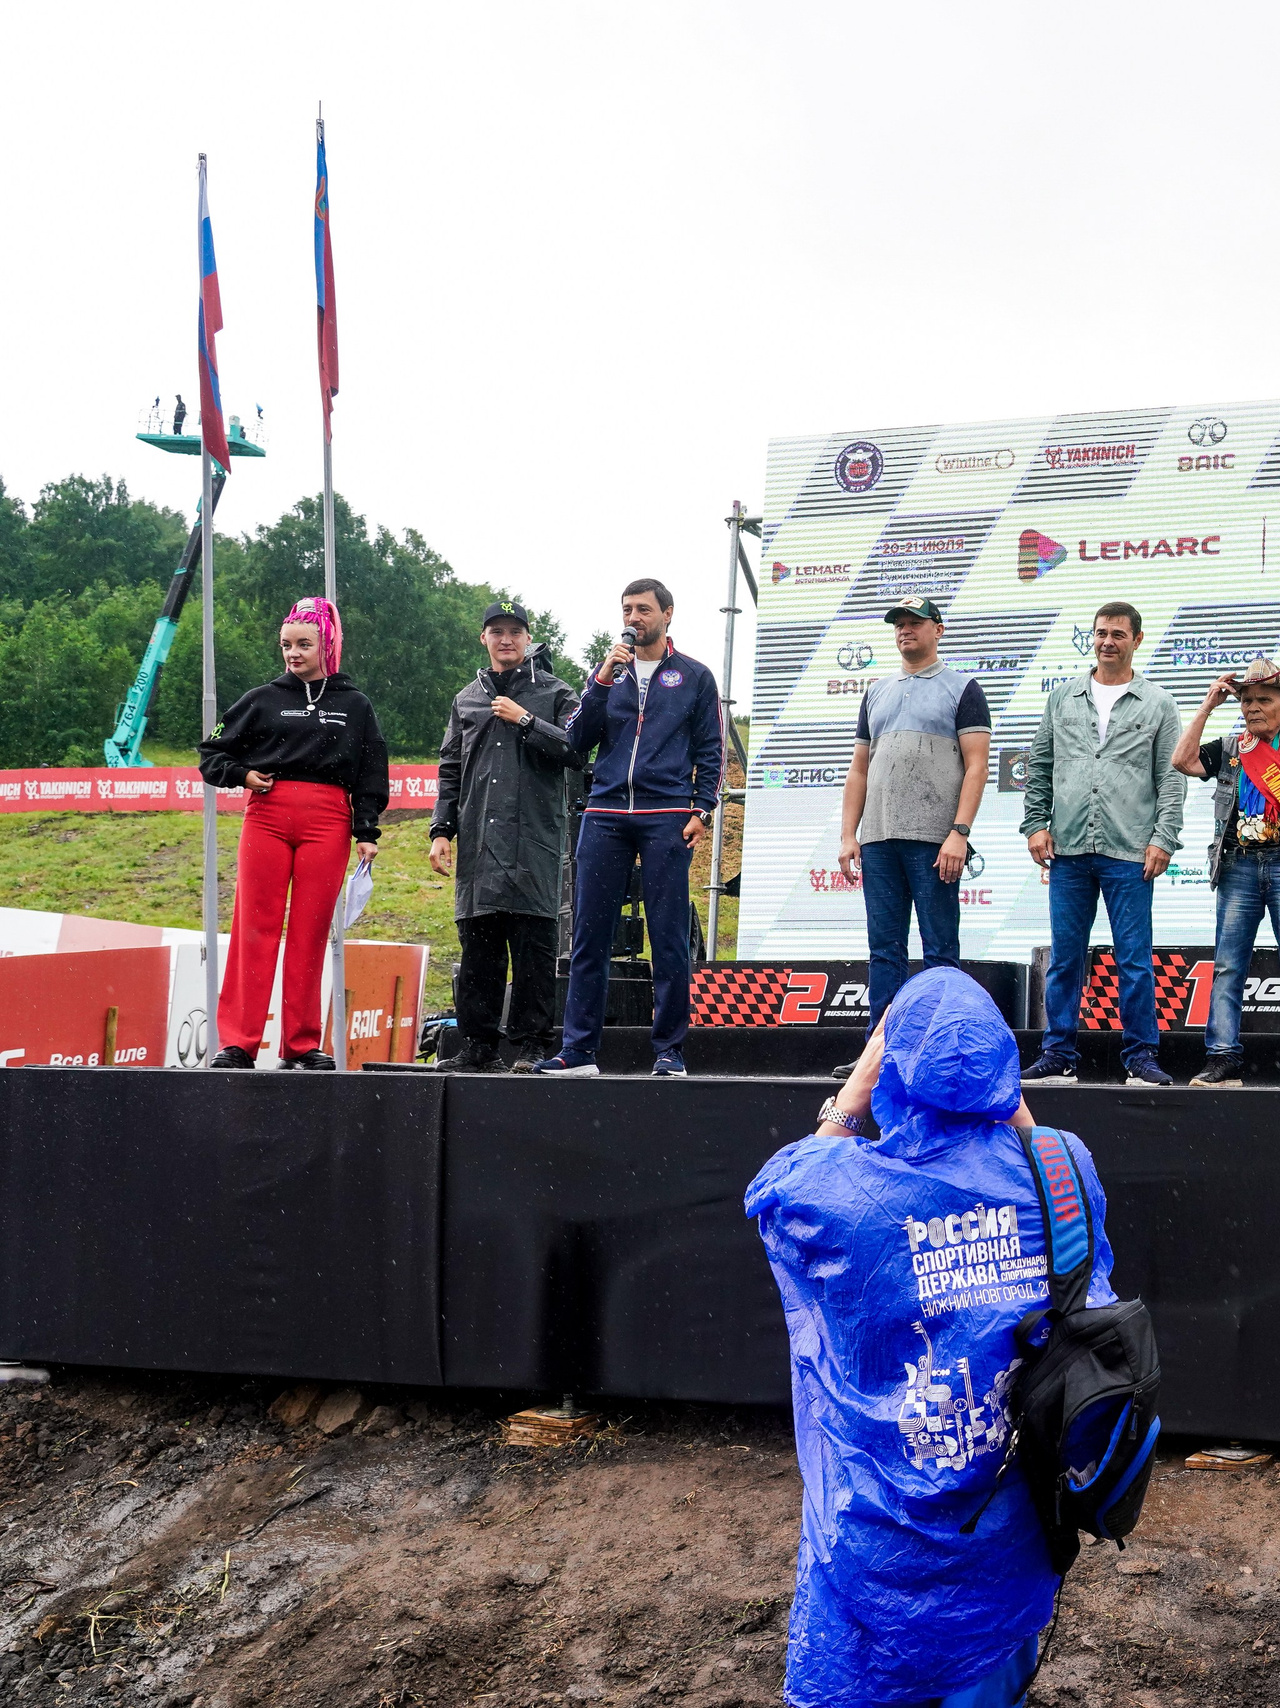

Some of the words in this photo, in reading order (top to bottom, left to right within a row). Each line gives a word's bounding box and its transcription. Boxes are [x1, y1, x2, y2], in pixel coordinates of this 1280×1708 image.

[1066, 444, 1136, 462] YAKHNICH
[1177, 453, 1236, 472] BAIC
[882, 542, 918, 554] 20-21
[923, 539, 965, 551] ИЮЛЯ
[1078, 535, 1221, 562] LEMARC
[795, 564, 851, 575] LEMARC
[1173, 637, 1219, 650] РЦСС
[1173, 650, 1265, 666] КУЗБАССА
[121, 704, 137, 729] 764
[134, 671, 149, 692] 200
[108, 755, 120, 765] 22
[787, 768, 836, 783] 2ГИС
[0, 783, 21, 796] NICH
[40, 781, 92, 795] YAKHNICH
[114, 780, 168, 794] YAKHNICH
[779, 972, 828, 1024] 2
[1185, 960, 1216, 1027] 1
[350, 1008, 383, 1040] BAIC
[50, 1053, 83, 1066] Все
[88, 1052, 99, 1066] в
[114, 1046, 147, 1063] иле
[1033, 1135, 1080, 1223] RUSSIA
[903, 1203, 1019, 1253] РОССИЯ
[912, 1236, 1021, 1276] СПОРТИВНАЯ
[918, 1263, 999, 1301] ДЕРЖАВА
[1001, 1265, 1048, 1282] СПОРТИВНЫЙ
[921, 1290, 974, 1319] НИЖНИЙ
[975, 1283, 1038, 1305] НОВГОРОД,
